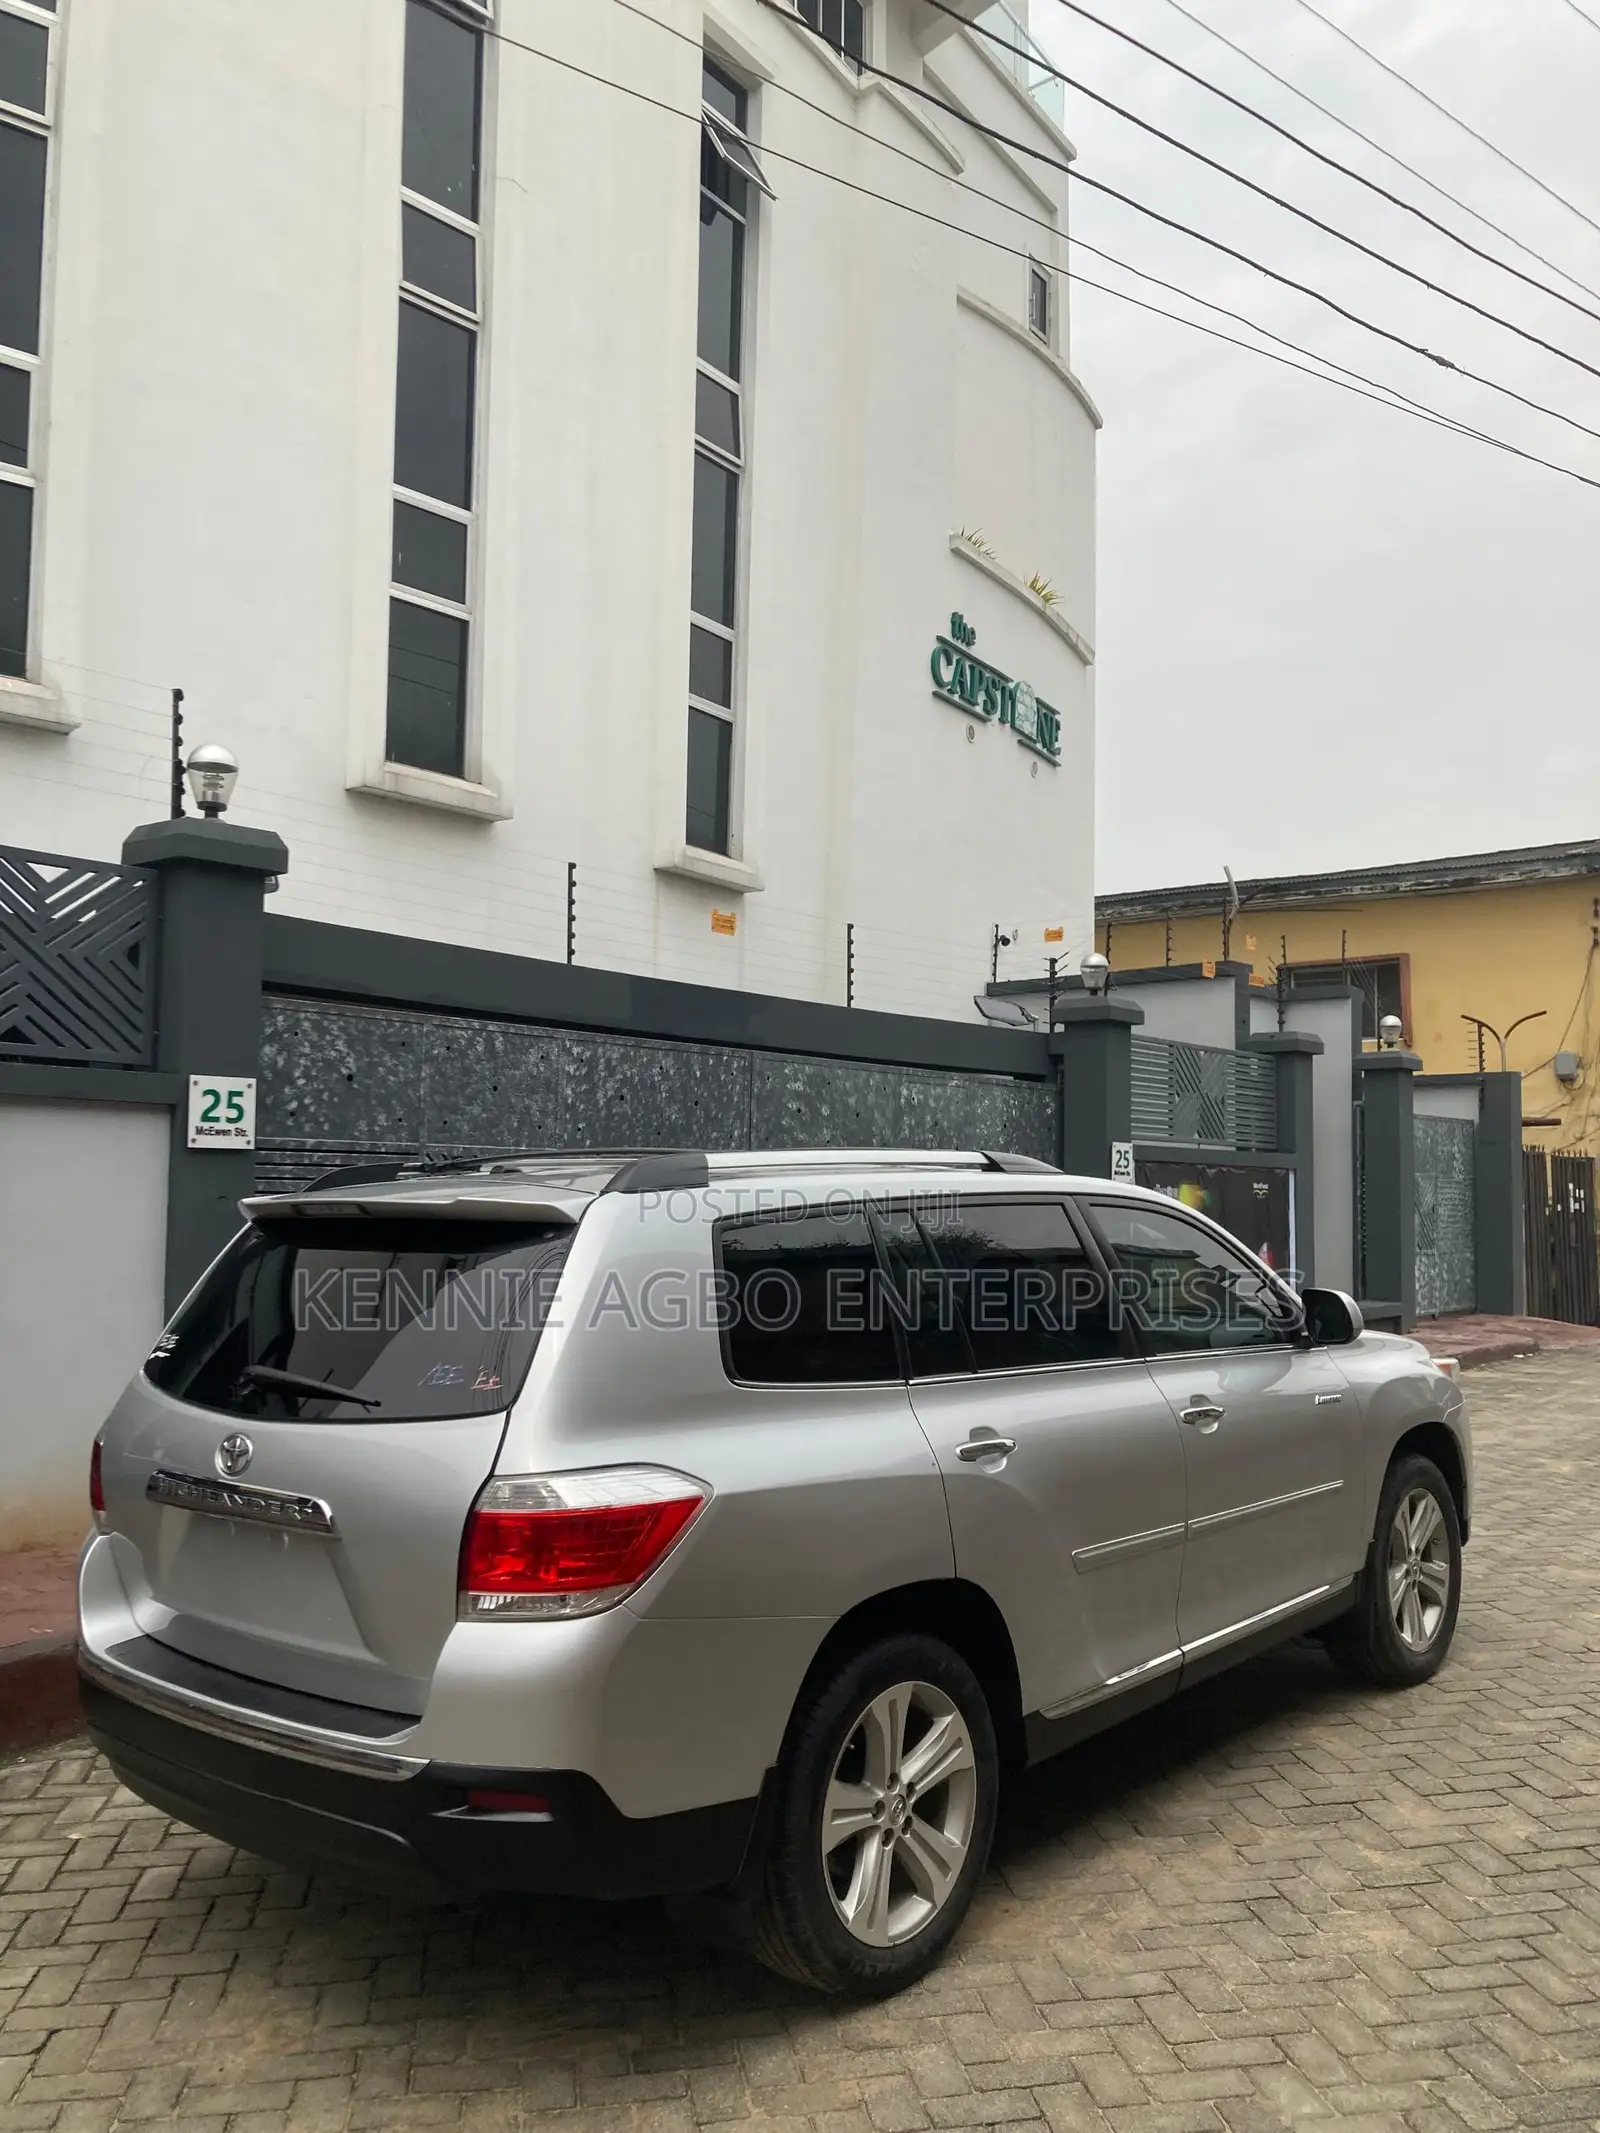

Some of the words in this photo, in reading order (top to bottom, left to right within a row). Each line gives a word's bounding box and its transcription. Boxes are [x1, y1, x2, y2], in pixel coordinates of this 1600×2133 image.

[950, 611, 977, 647] the
[930, 645, 1062, 757] CAPSTONE
[200, 1088, 245, 1125] 25
[195, 1125, 233, 1137] McEwen
[234, 1126, 249, 1138] Str.
[1115, 1149, 1130, 1170] 25
